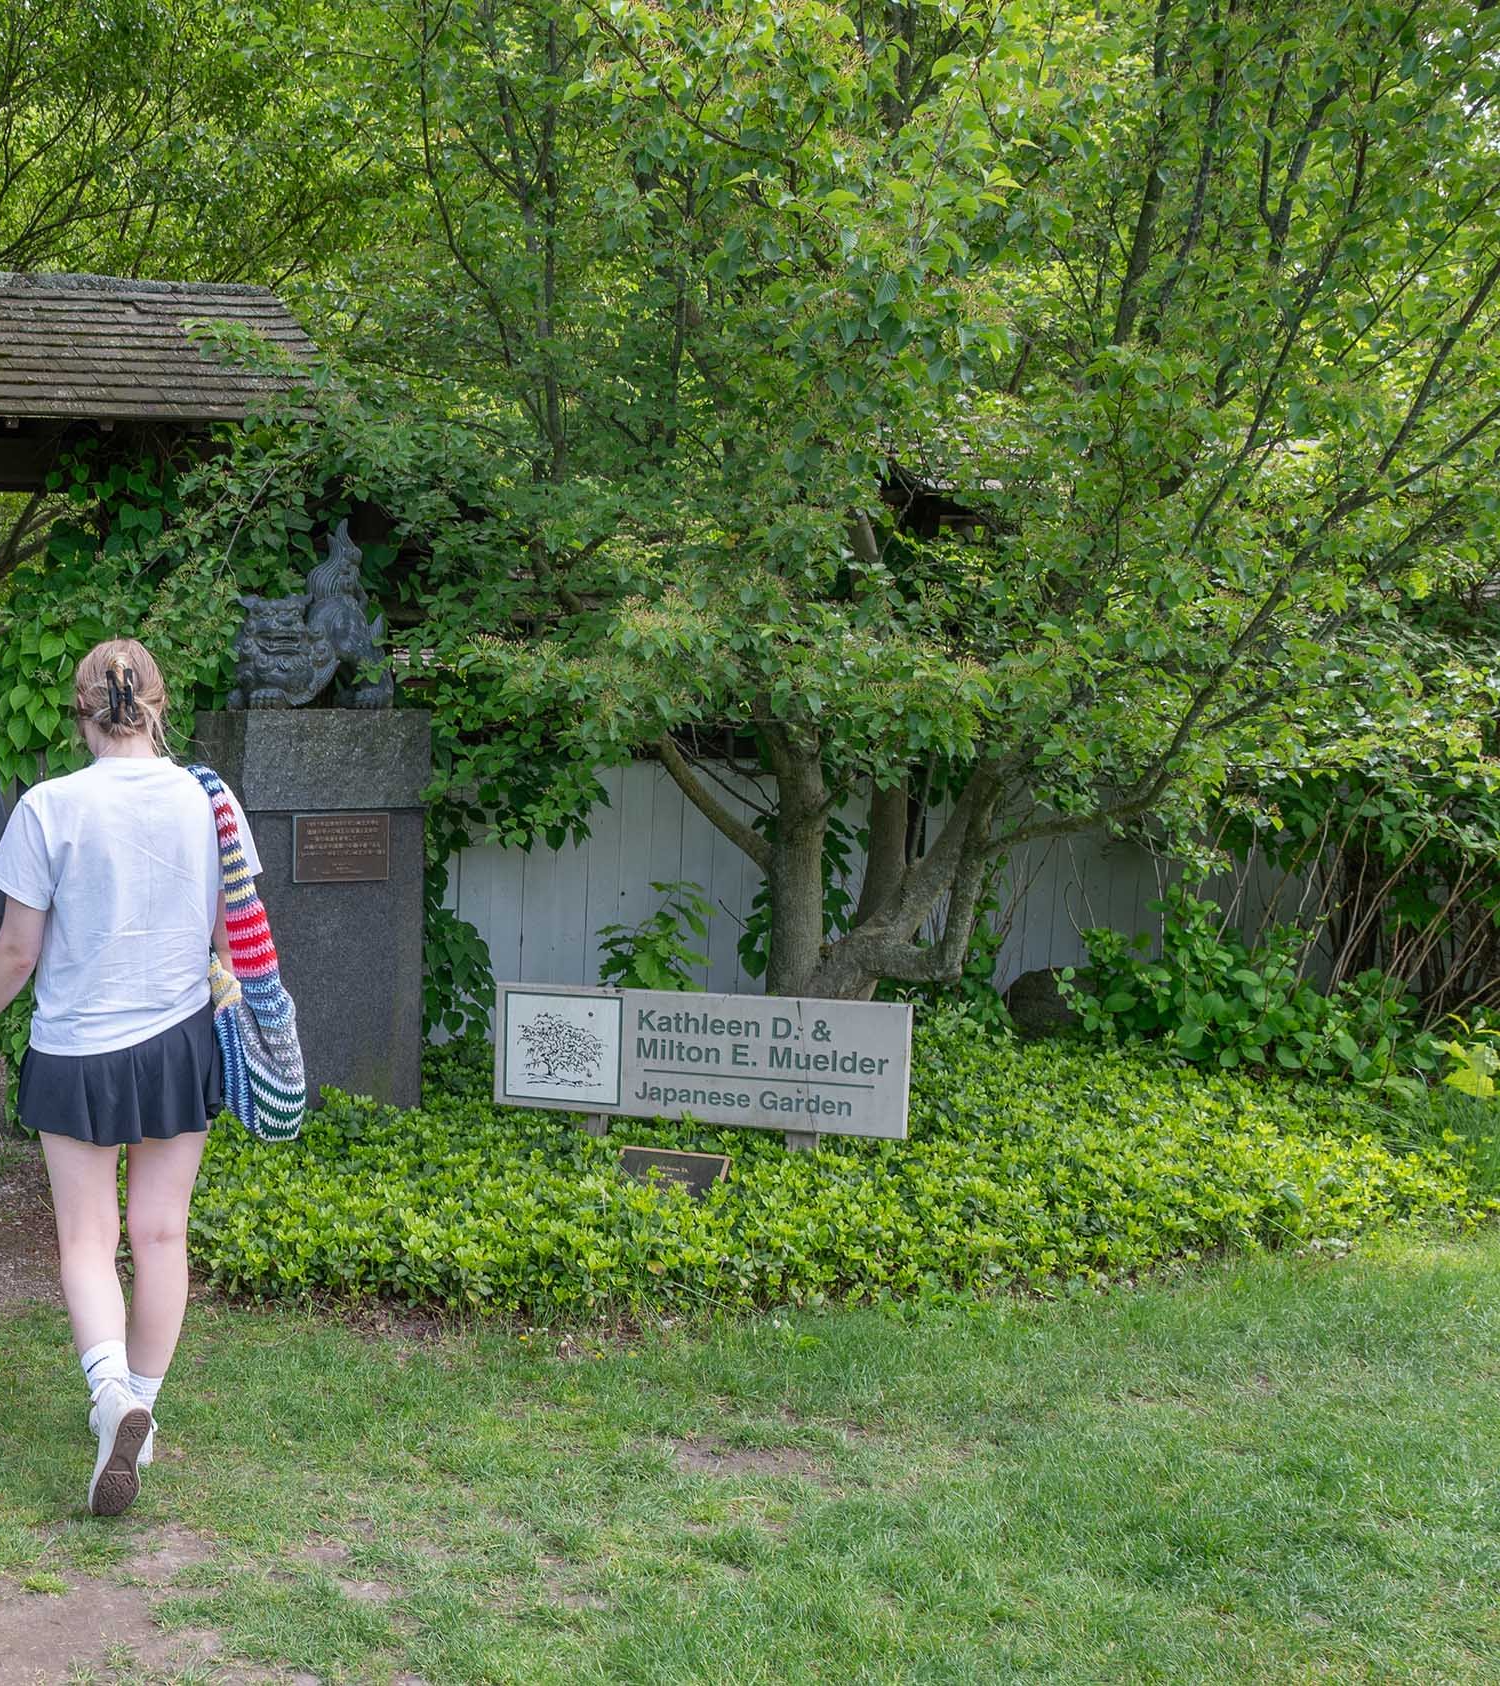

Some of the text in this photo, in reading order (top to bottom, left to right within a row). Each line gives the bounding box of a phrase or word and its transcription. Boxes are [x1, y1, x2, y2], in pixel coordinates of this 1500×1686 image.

[637, 1010, 832, 1042] Kathleen D. &
[636, 1038, 889, 1075] Milton E. Muelder
[635, 1082, 852, 1116] Japanese Garden
